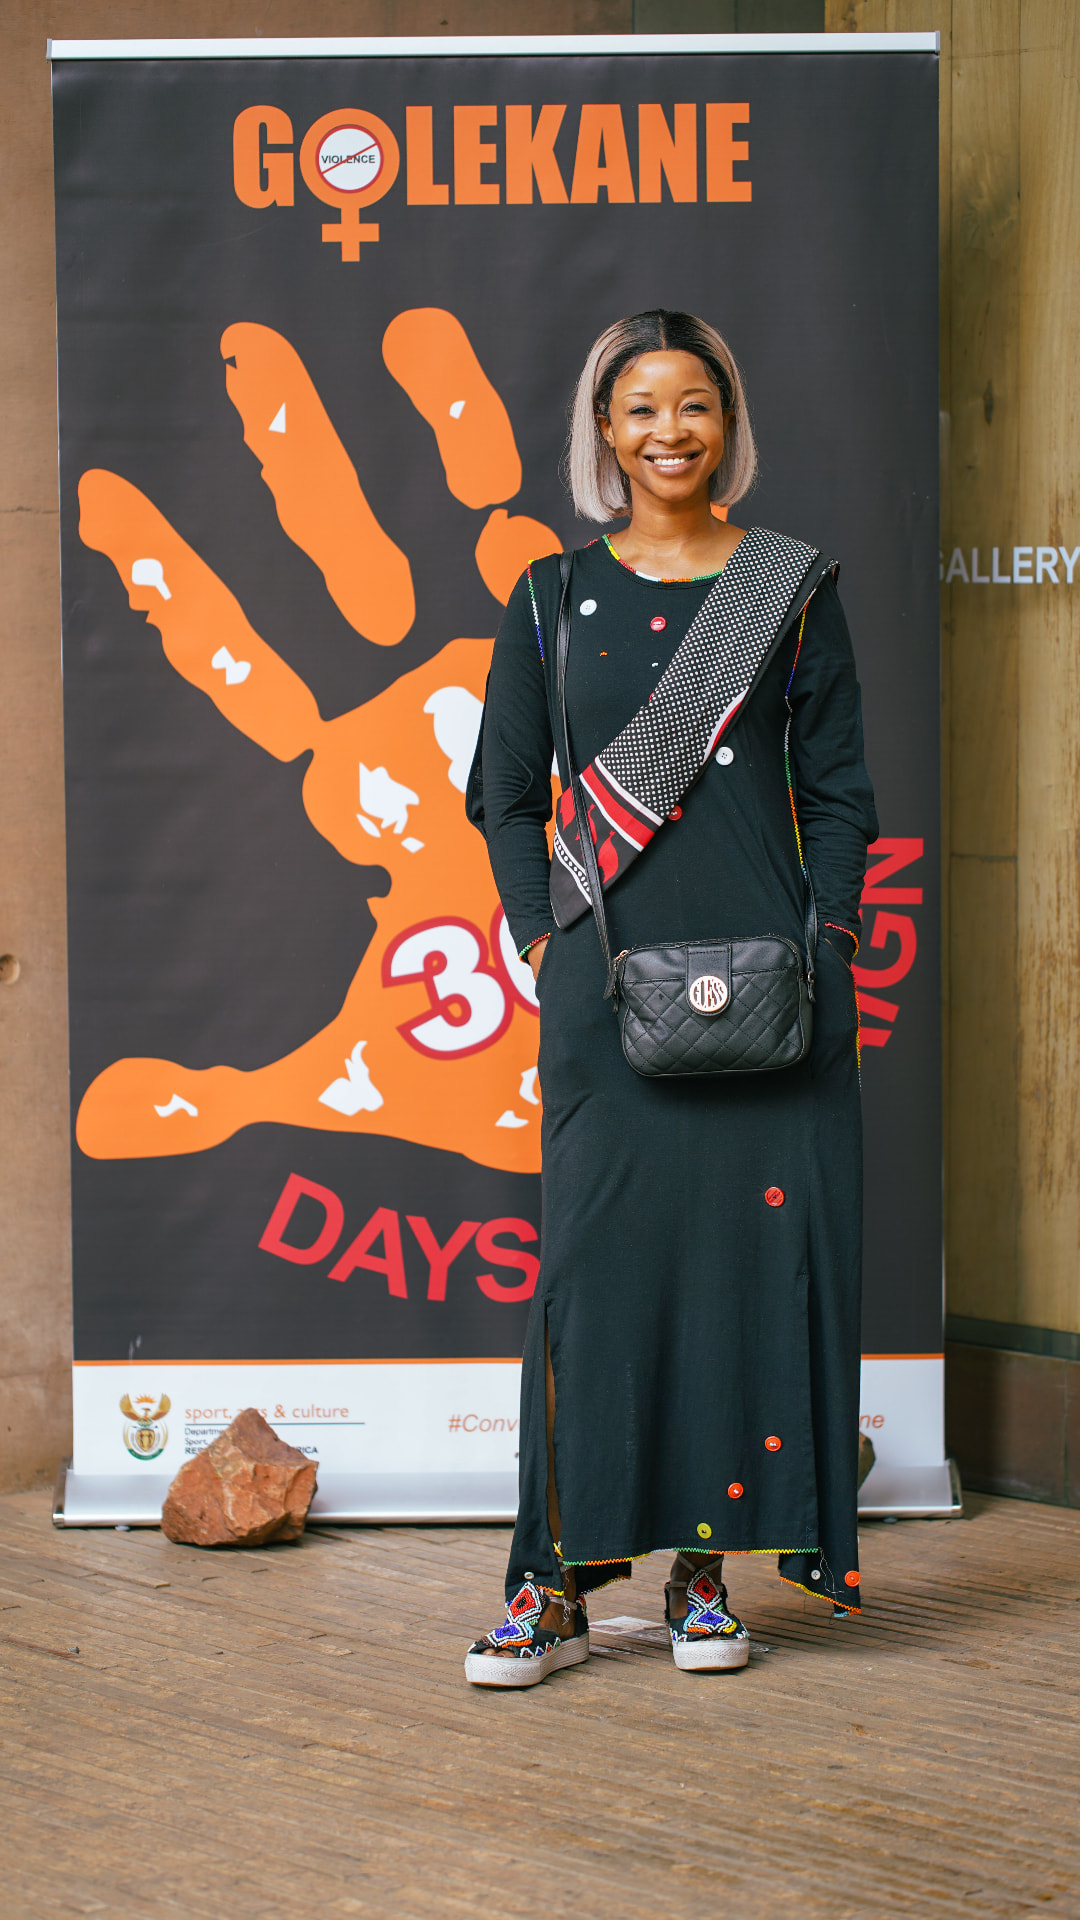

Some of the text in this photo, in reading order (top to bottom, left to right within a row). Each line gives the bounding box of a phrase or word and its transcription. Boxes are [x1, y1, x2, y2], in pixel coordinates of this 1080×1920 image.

[321, 155, 376, 164] VIOLENCE
[233, 103, 752, 262] GOLEKANE
[258, 1172, 541, 1303] DAYS
[185, 1408, 232, 1424] sport,
[274, 1404, 287, 1418] &
[292, 1404, 349, 1418] culture
[448, 1414, 884, 1432] #Conv ne
